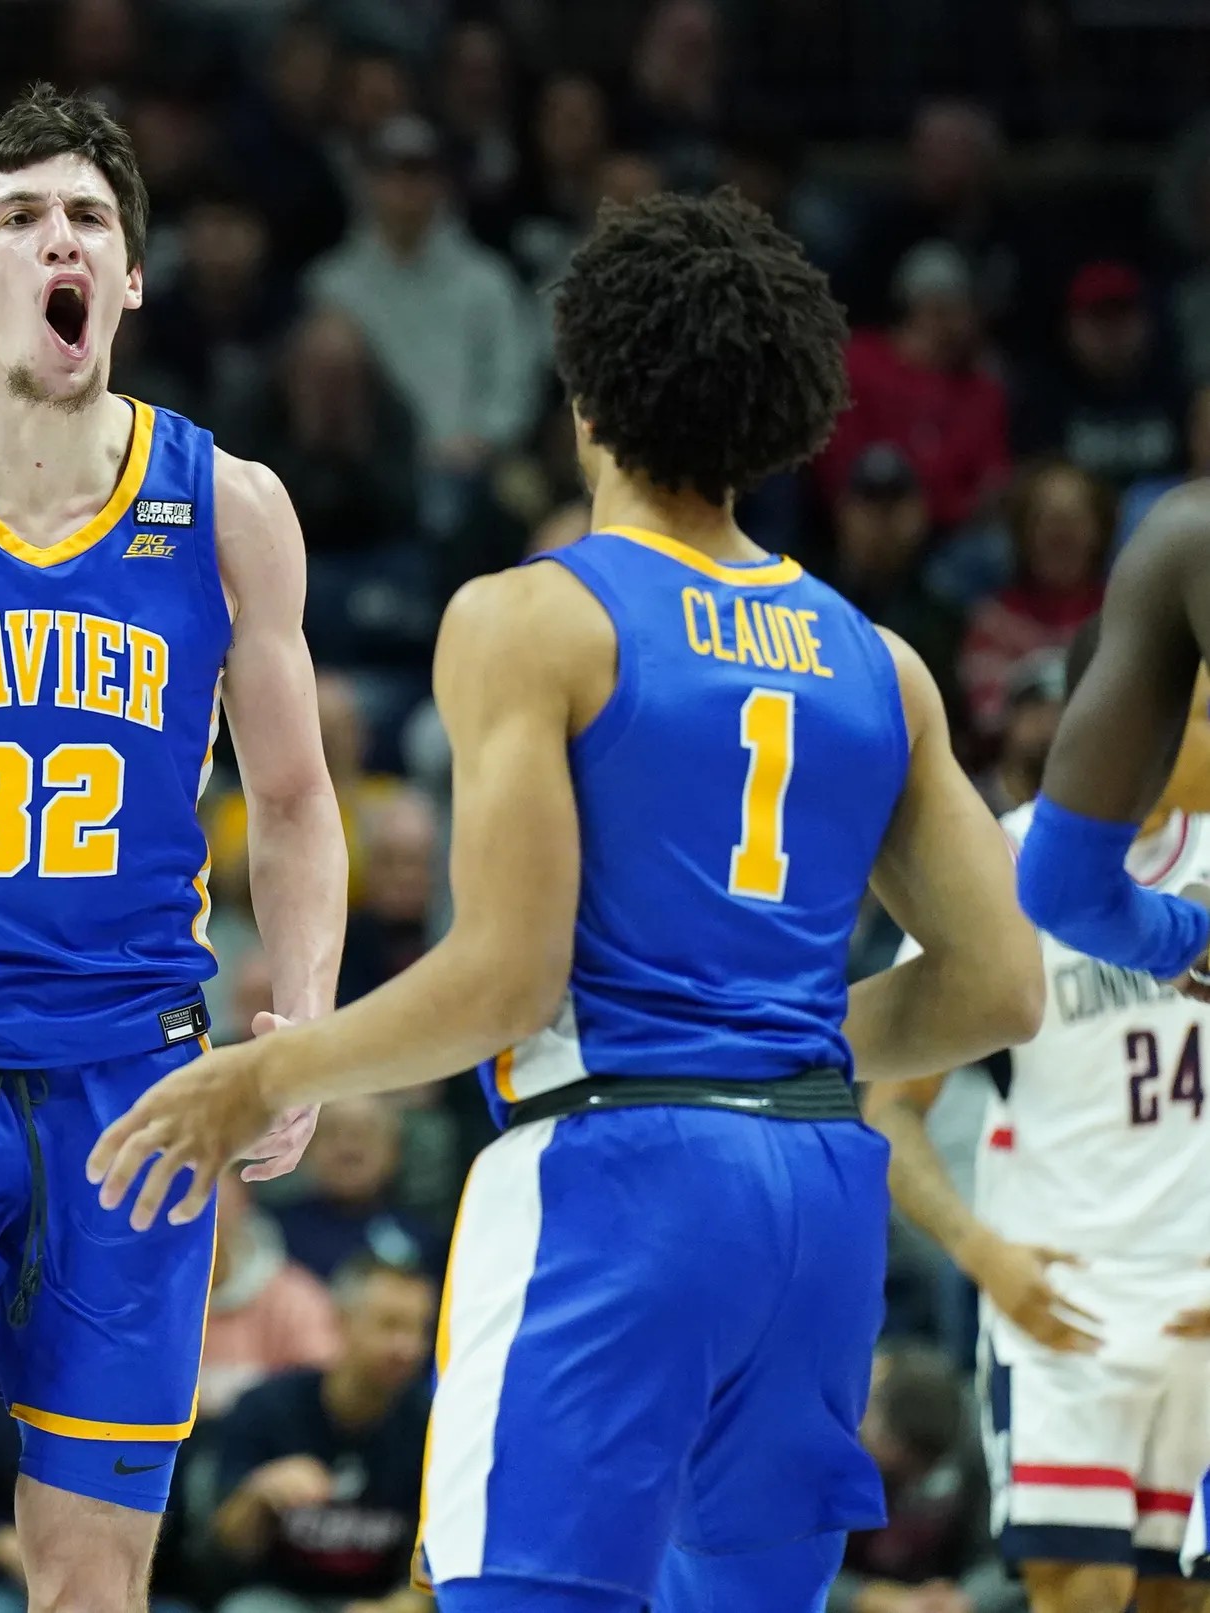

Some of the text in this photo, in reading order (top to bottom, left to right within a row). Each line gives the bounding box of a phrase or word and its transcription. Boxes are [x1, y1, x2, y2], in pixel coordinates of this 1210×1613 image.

[137, 513, 192, 525] CHANGE
[132, 534, 168, 546] BIG
[126, 544, 177, 556] EAST
[681, 586, 835, 678] CLAUDE
[728, 686, 795, 903] 1
[195, 1013, 203, 1026] L
[1125, 1023, 1205, 1125] 24
